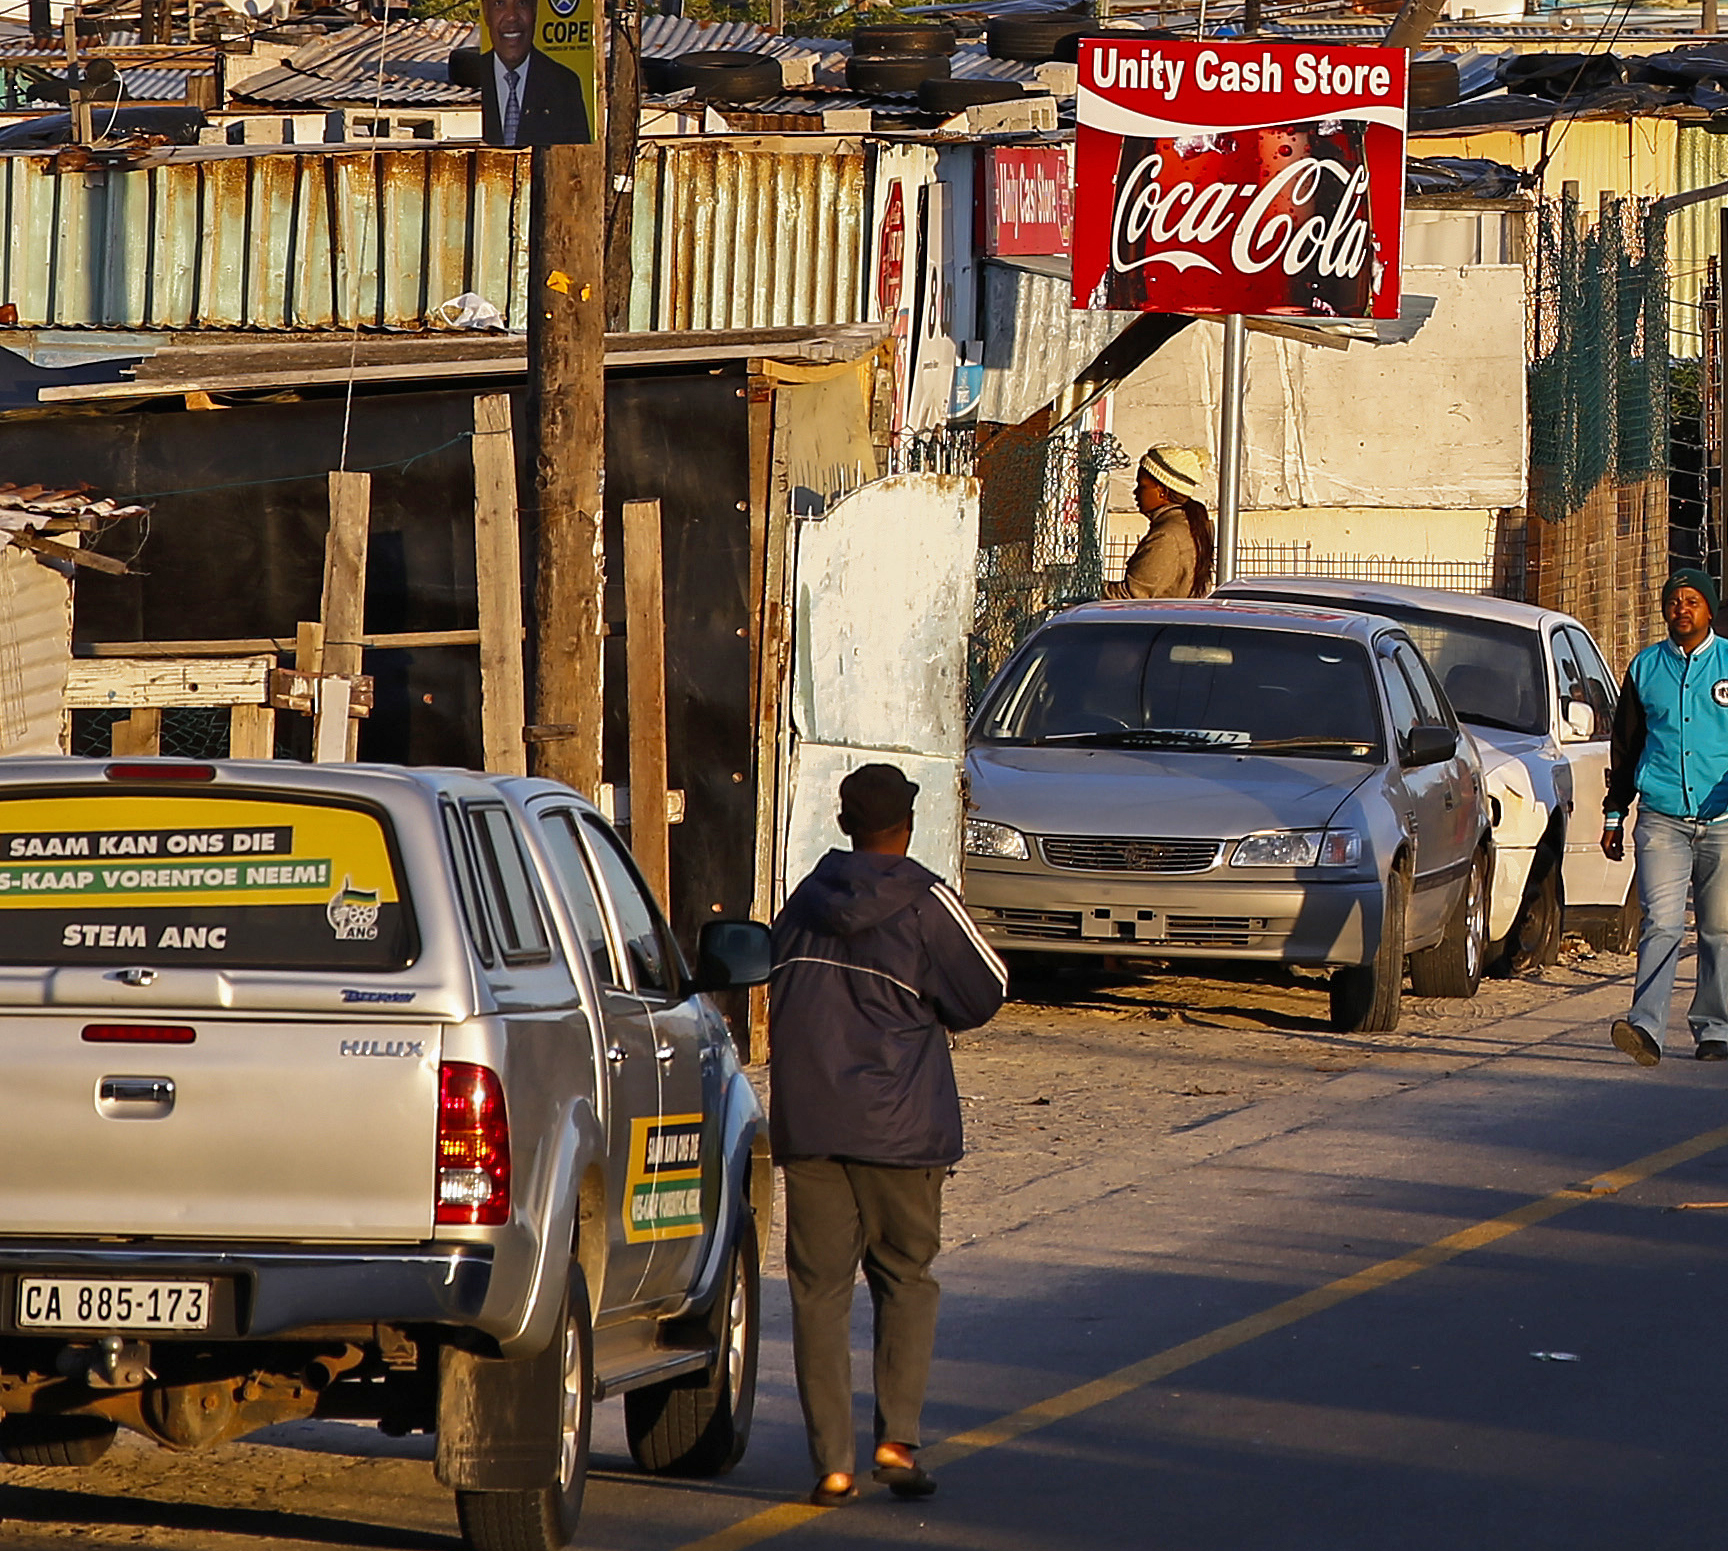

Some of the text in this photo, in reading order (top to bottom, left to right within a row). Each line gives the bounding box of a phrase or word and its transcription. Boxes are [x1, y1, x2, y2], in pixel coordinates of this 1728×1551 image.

[542, 21, 589, 44] COPE
[1092, 48, 1391, 100] Unity Cash Store
[999, 162, 1057, 240] Unity Cash Store
[1112, 154, 1369, 280] Coca-Cola
[9, 832, 276, 857] SAAM KAN ONS DIE
[102, 867, 239, 888] VORENTOE
[246, 864, 327, 885] NEEM!
[62, 923, 228, 949] STEM ANC
[346, 926, 378, 940] ANC
[340, 1040, 426, 1057] HILUX
[26, 1286, 203, 1322] CA 885-173
